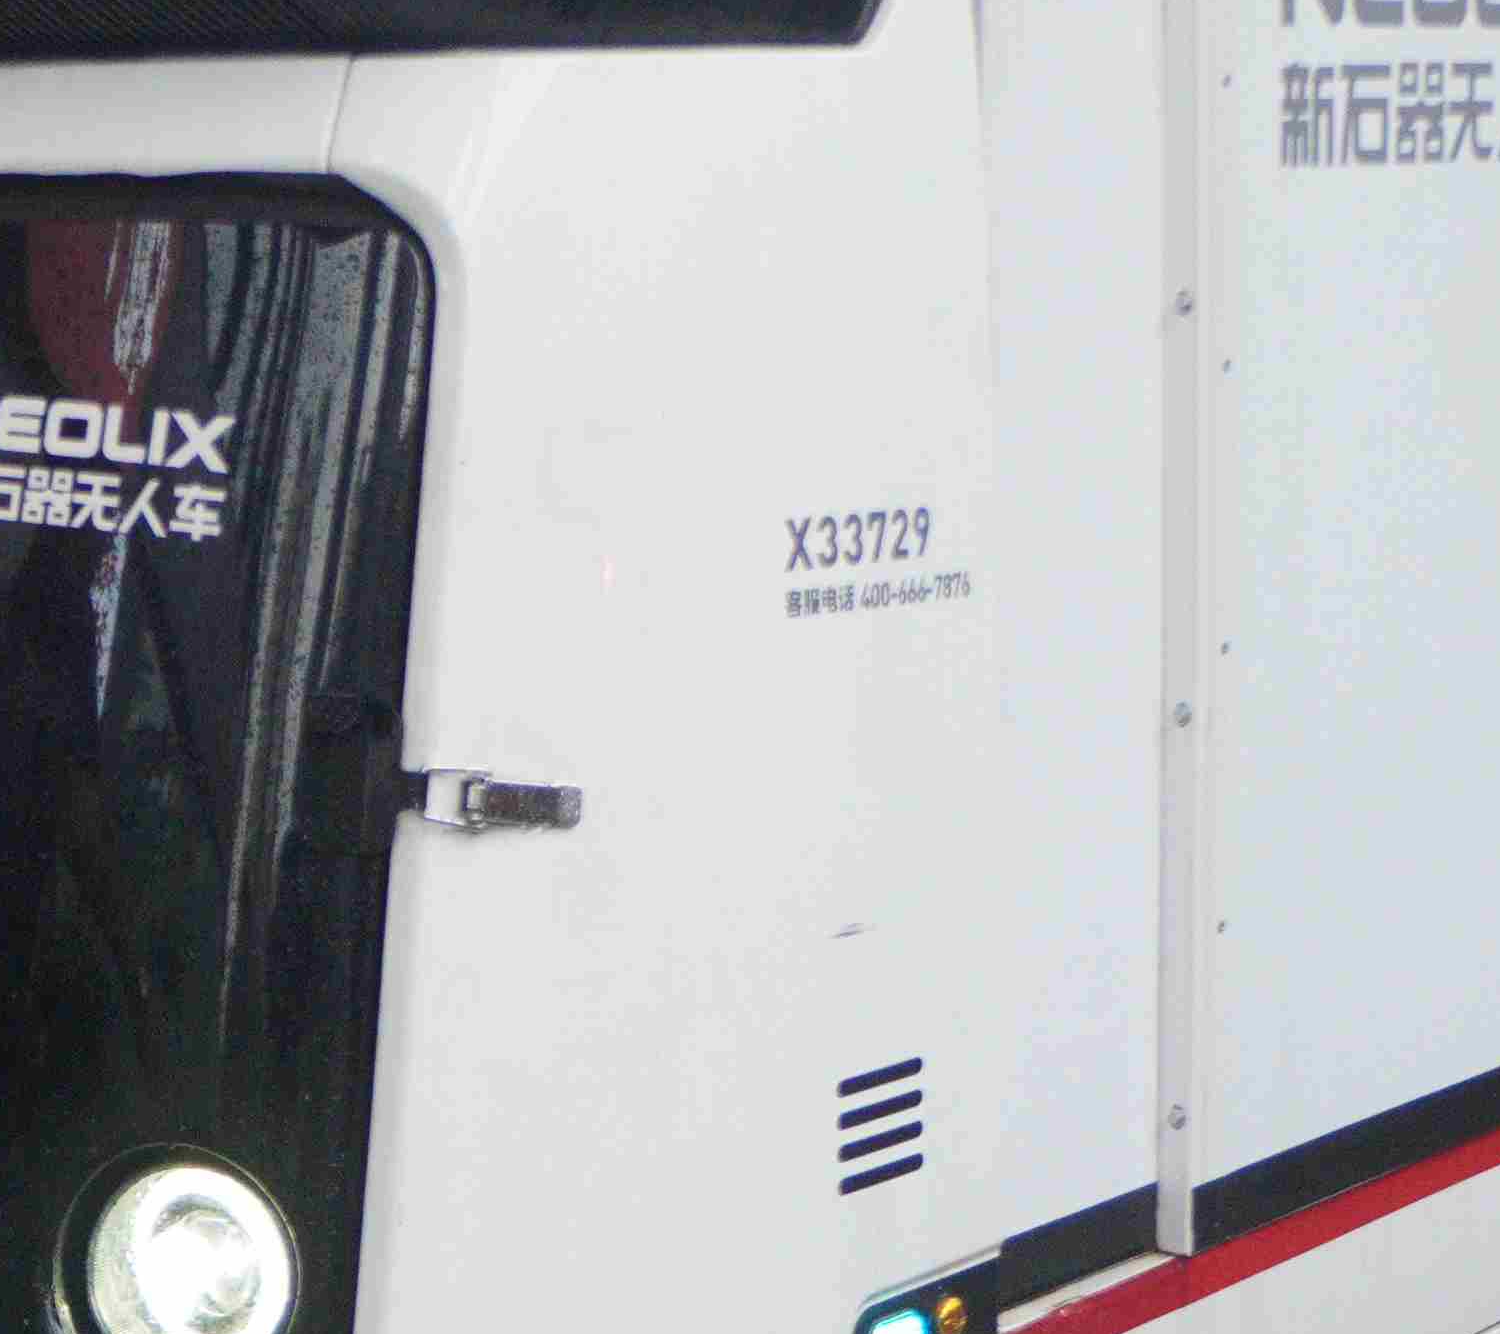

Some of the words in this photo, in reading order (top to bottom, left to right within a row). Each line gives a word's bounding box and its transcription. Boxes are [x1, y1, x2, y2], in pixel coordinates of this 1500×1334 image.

[784, 505, 932, 573] X33729
[784, 584, 854, 618] 客服电话
